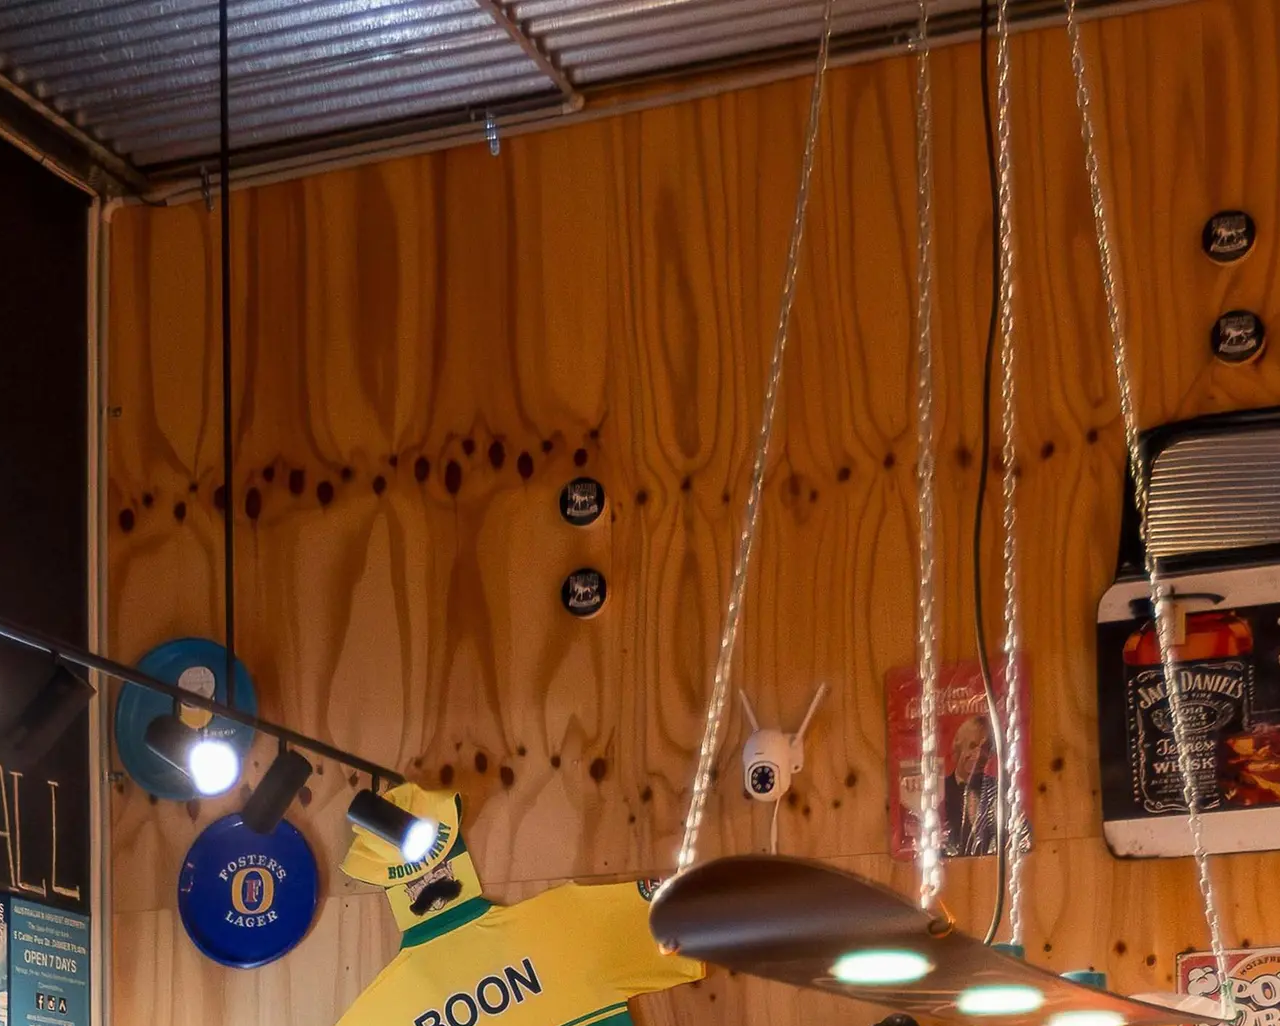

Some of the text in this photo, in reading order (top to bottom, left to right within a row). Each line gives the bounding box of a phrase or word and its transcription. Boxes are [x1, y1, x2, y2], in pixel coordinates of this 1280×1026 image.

[1138, 671, 1246, 709] JAC DANIEL'S
[219, 854, 287, 882] FOSTER'S
[225, 909, 279, 928] LAGER
[24, 949, 77, 973] OPEN 7 DAYS
